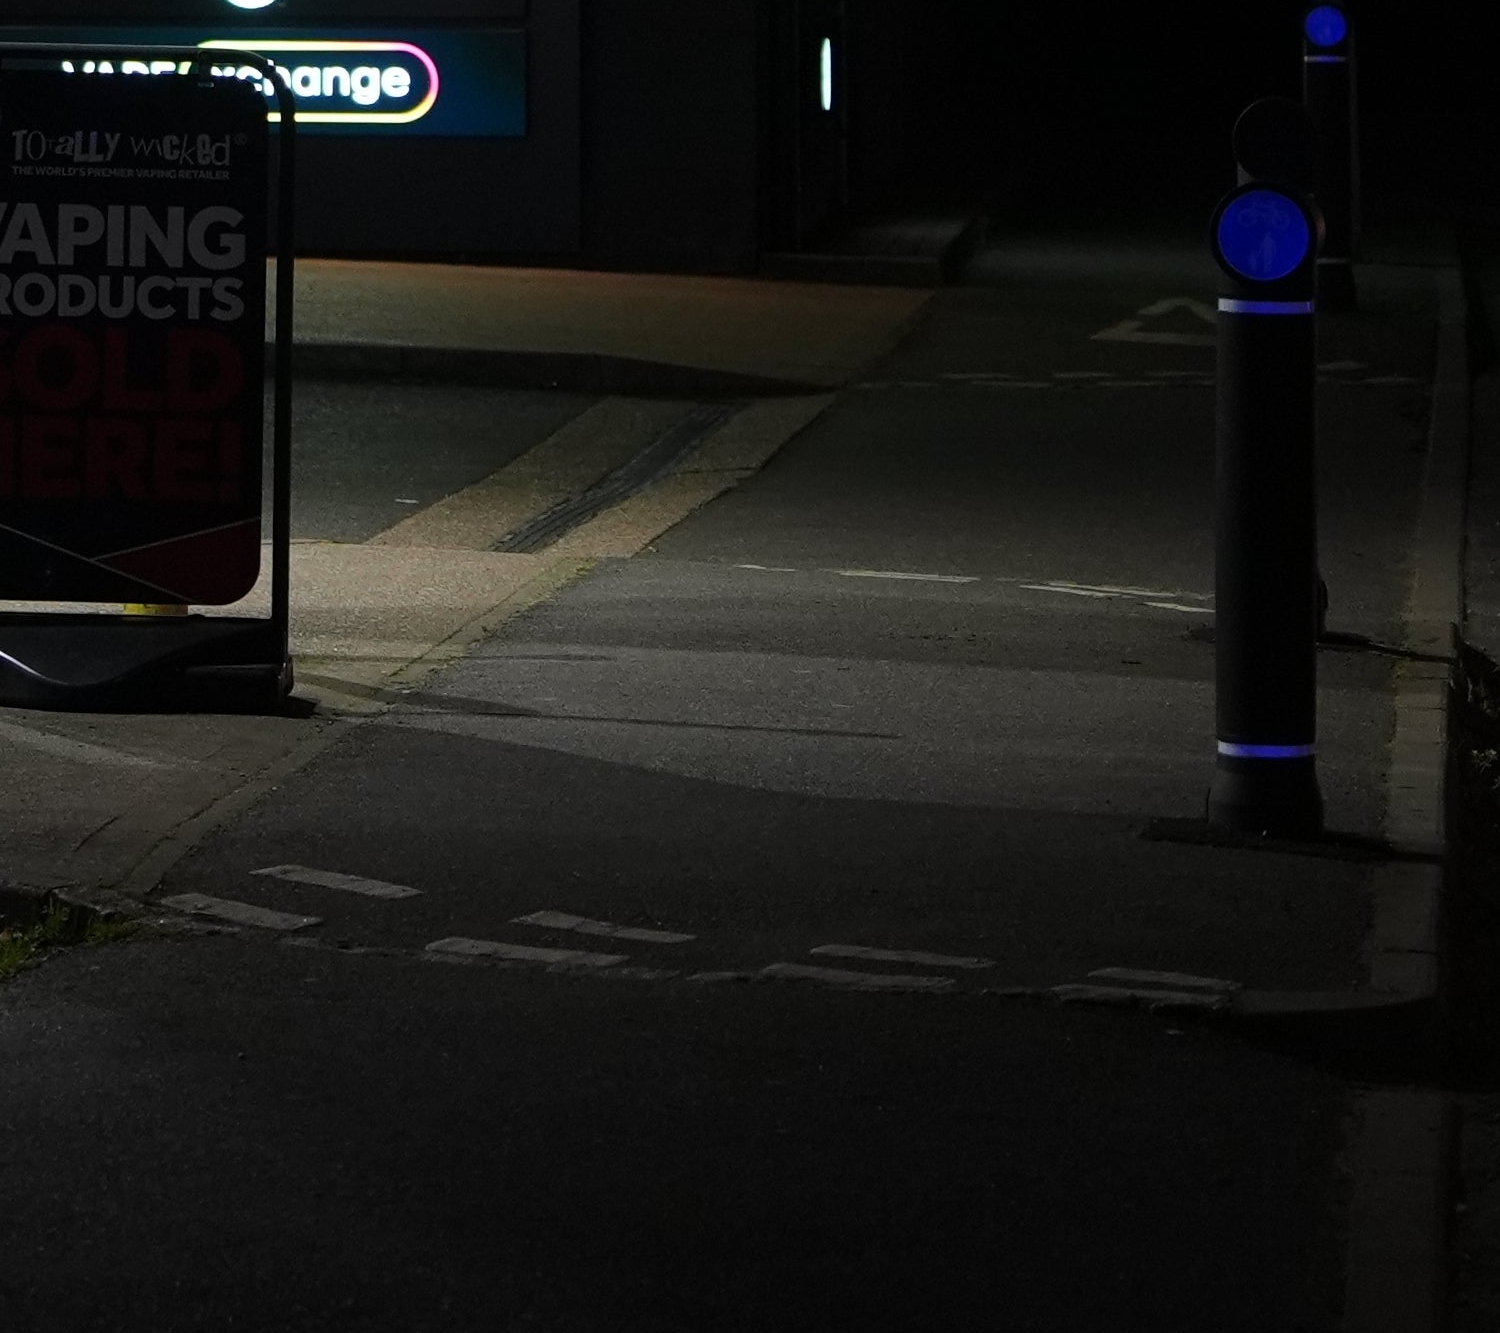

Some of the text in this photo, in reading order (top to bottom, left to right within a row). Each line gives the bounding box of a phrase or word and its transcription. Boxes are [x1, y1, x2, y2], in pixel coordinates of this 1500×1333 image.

[11, 164, 231, 181] THE WORLD'S PREMIER VAPING RETAILER
